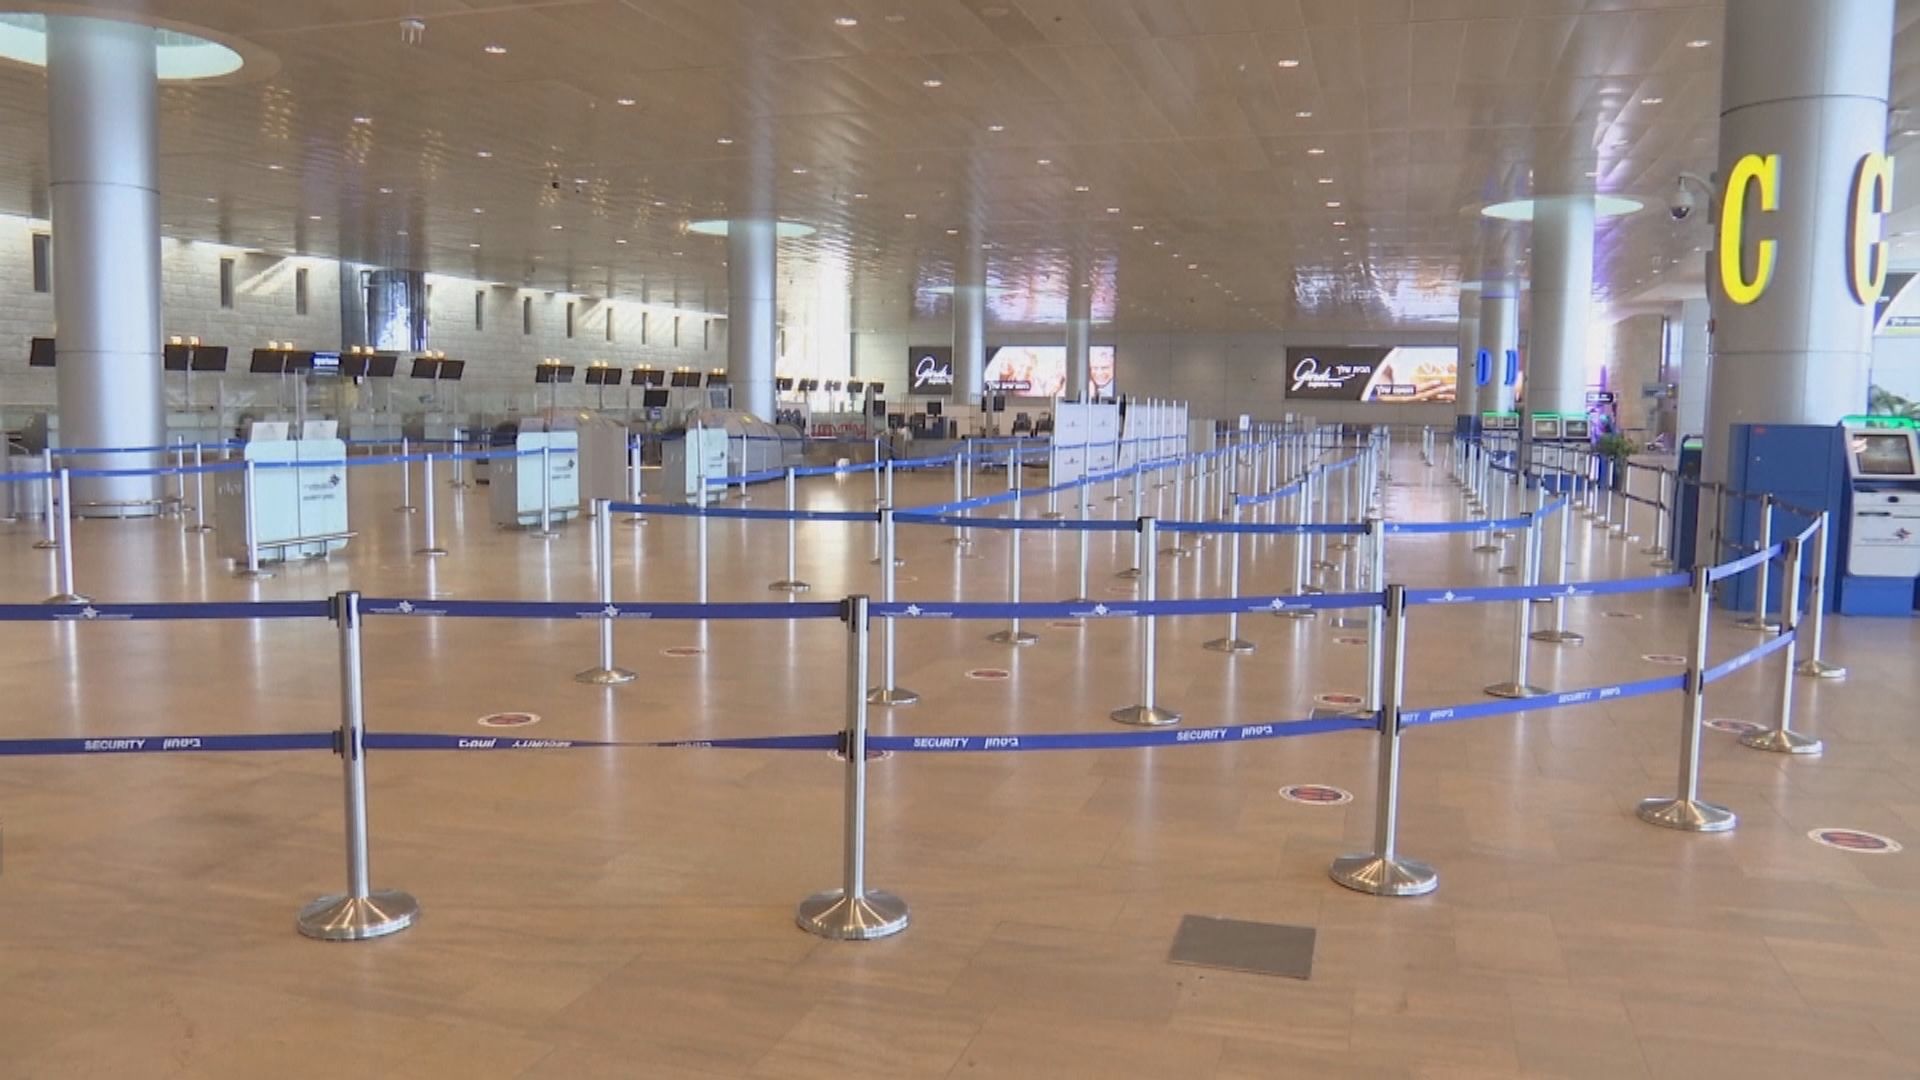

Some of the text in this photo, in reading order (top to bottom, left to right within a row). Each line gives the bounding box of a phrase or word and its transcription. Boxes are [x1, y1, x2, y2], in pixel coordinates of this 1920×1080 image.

[1720, 153, 1780, 304] C
[1847, 152, 1894, 306] C
[1176, 725, 1273, 741] SECURITY ביטחון
[84, 738, 202, 751] SECURITY ביטחון
[913, 737, 1019, 749] SECURITY ביטחון
